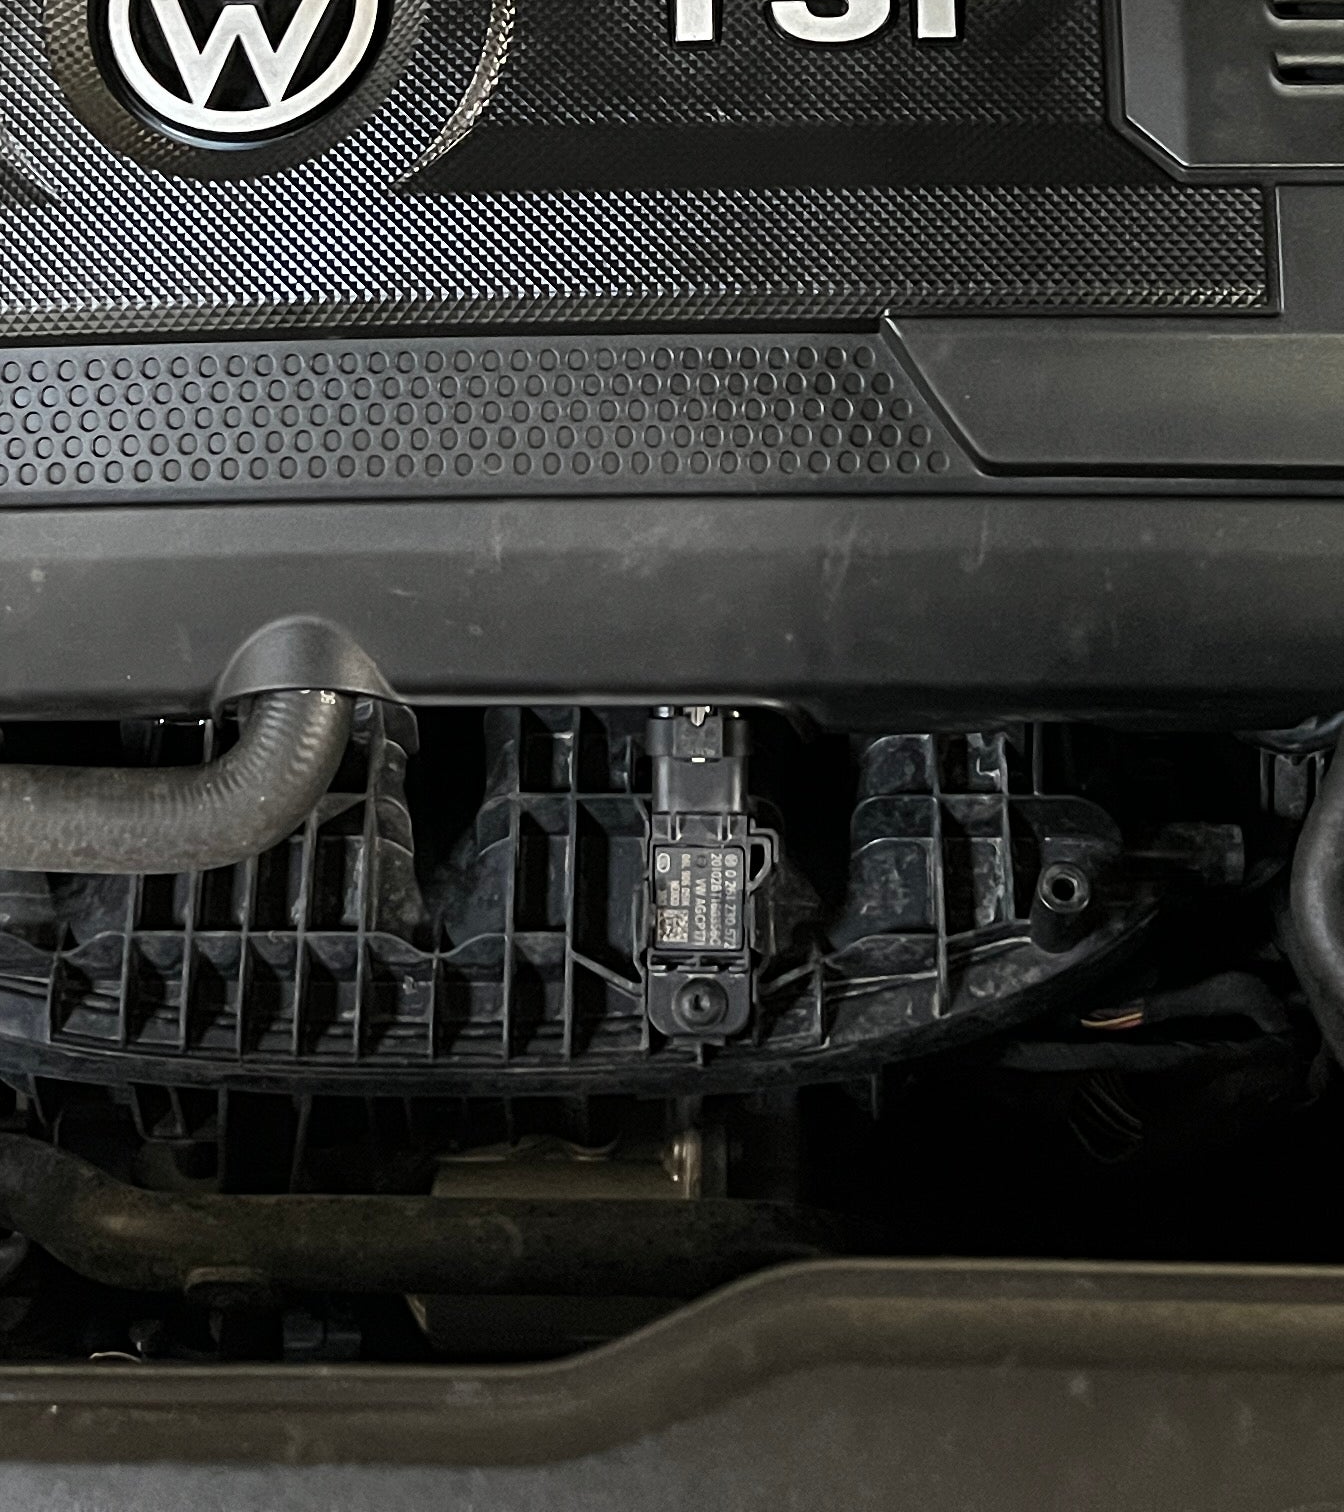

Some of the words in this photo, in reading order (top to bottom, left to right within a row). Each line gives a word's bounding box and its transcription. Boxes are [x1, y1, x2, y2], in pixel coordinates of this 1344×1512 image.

[694, 877, 706, 896] VW
[723, 880, 736, 899] 261
[694, 897, 706, 914] AG
[723, 927, 736, 949] 572
